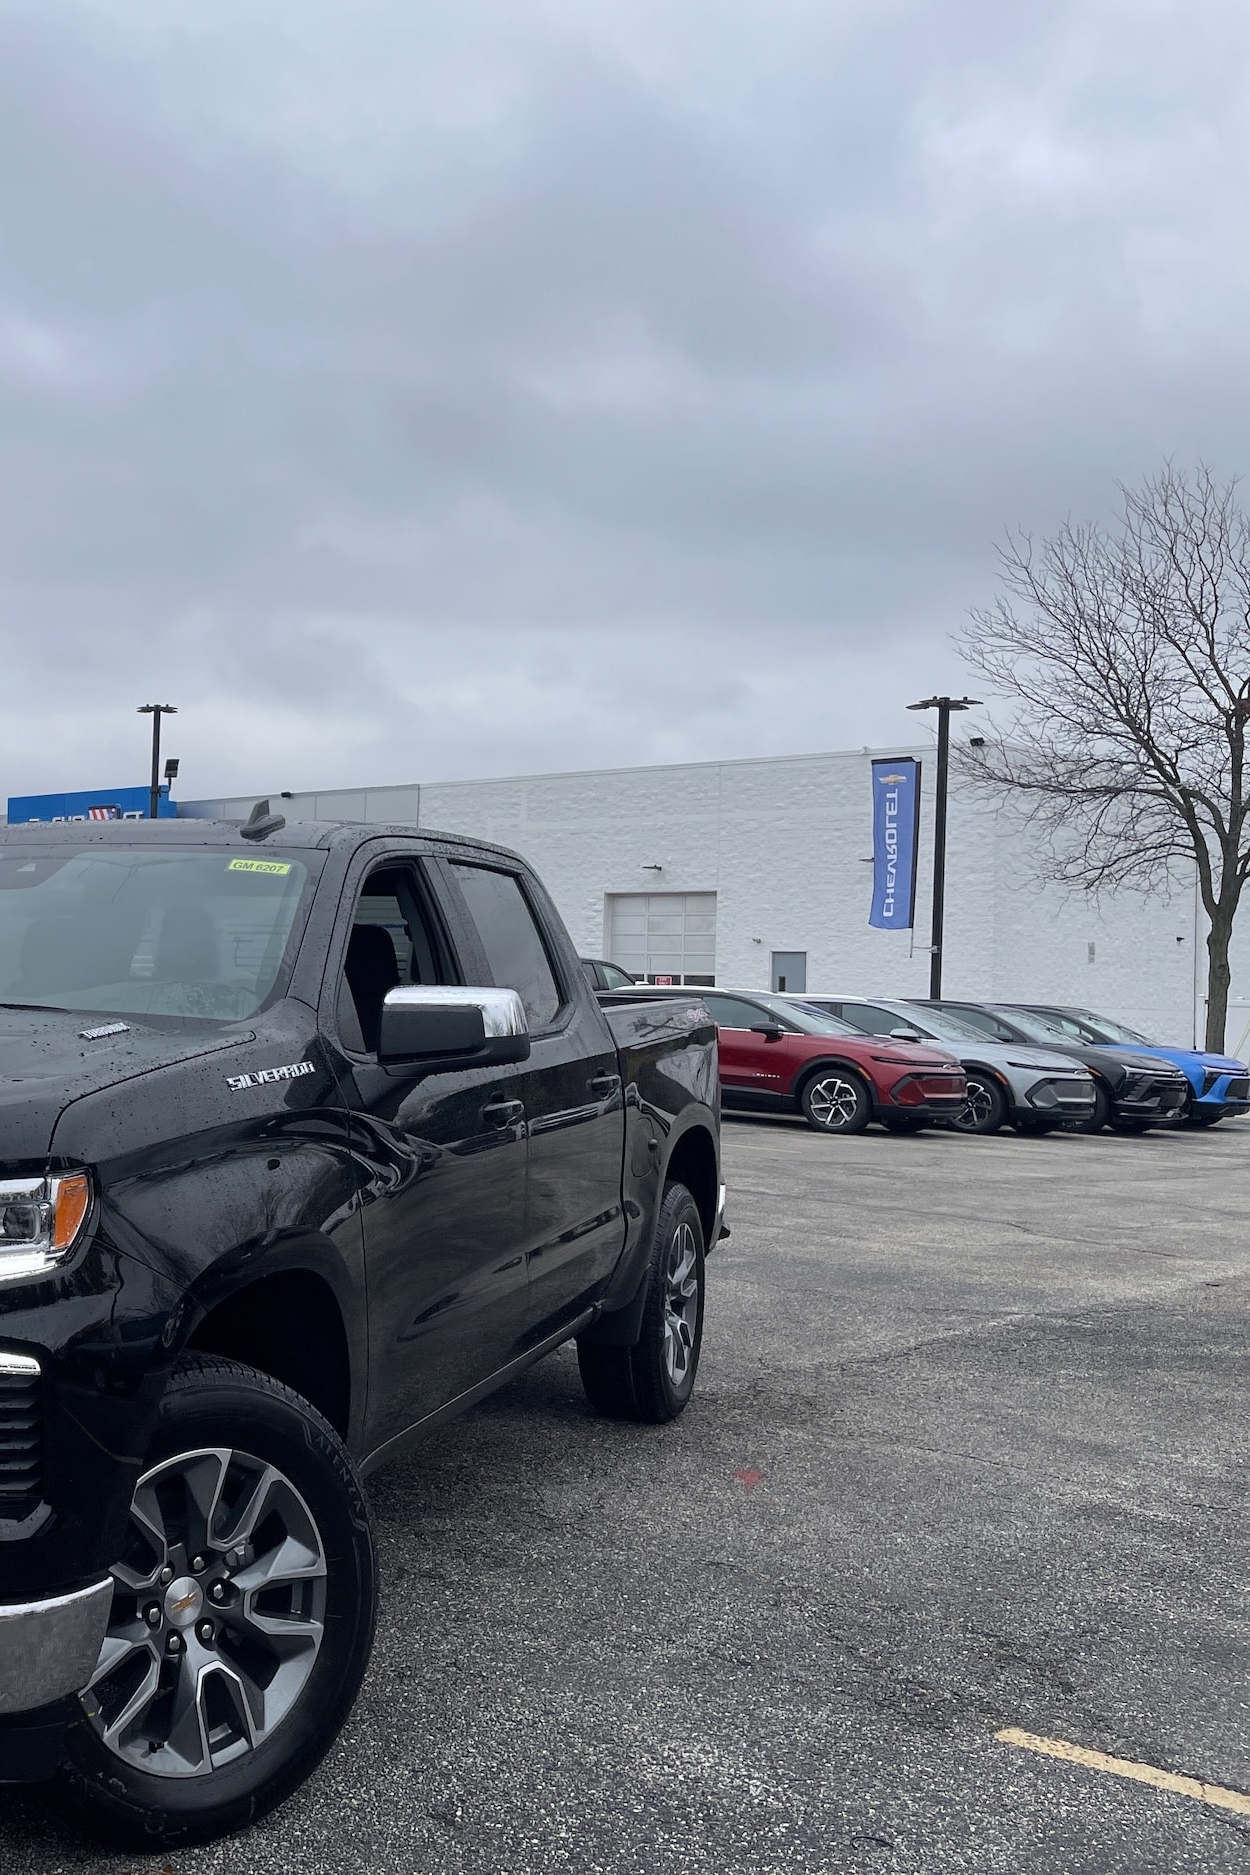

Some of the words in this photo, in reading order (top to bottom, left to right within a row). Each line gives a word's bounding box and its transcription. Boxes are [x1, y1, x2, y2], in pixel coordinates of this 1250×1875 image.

[233, 861, 254, 870] GM
[255, 863, 284, 873] 6207
[226, 1060, 316, 1092] SILVERADO
